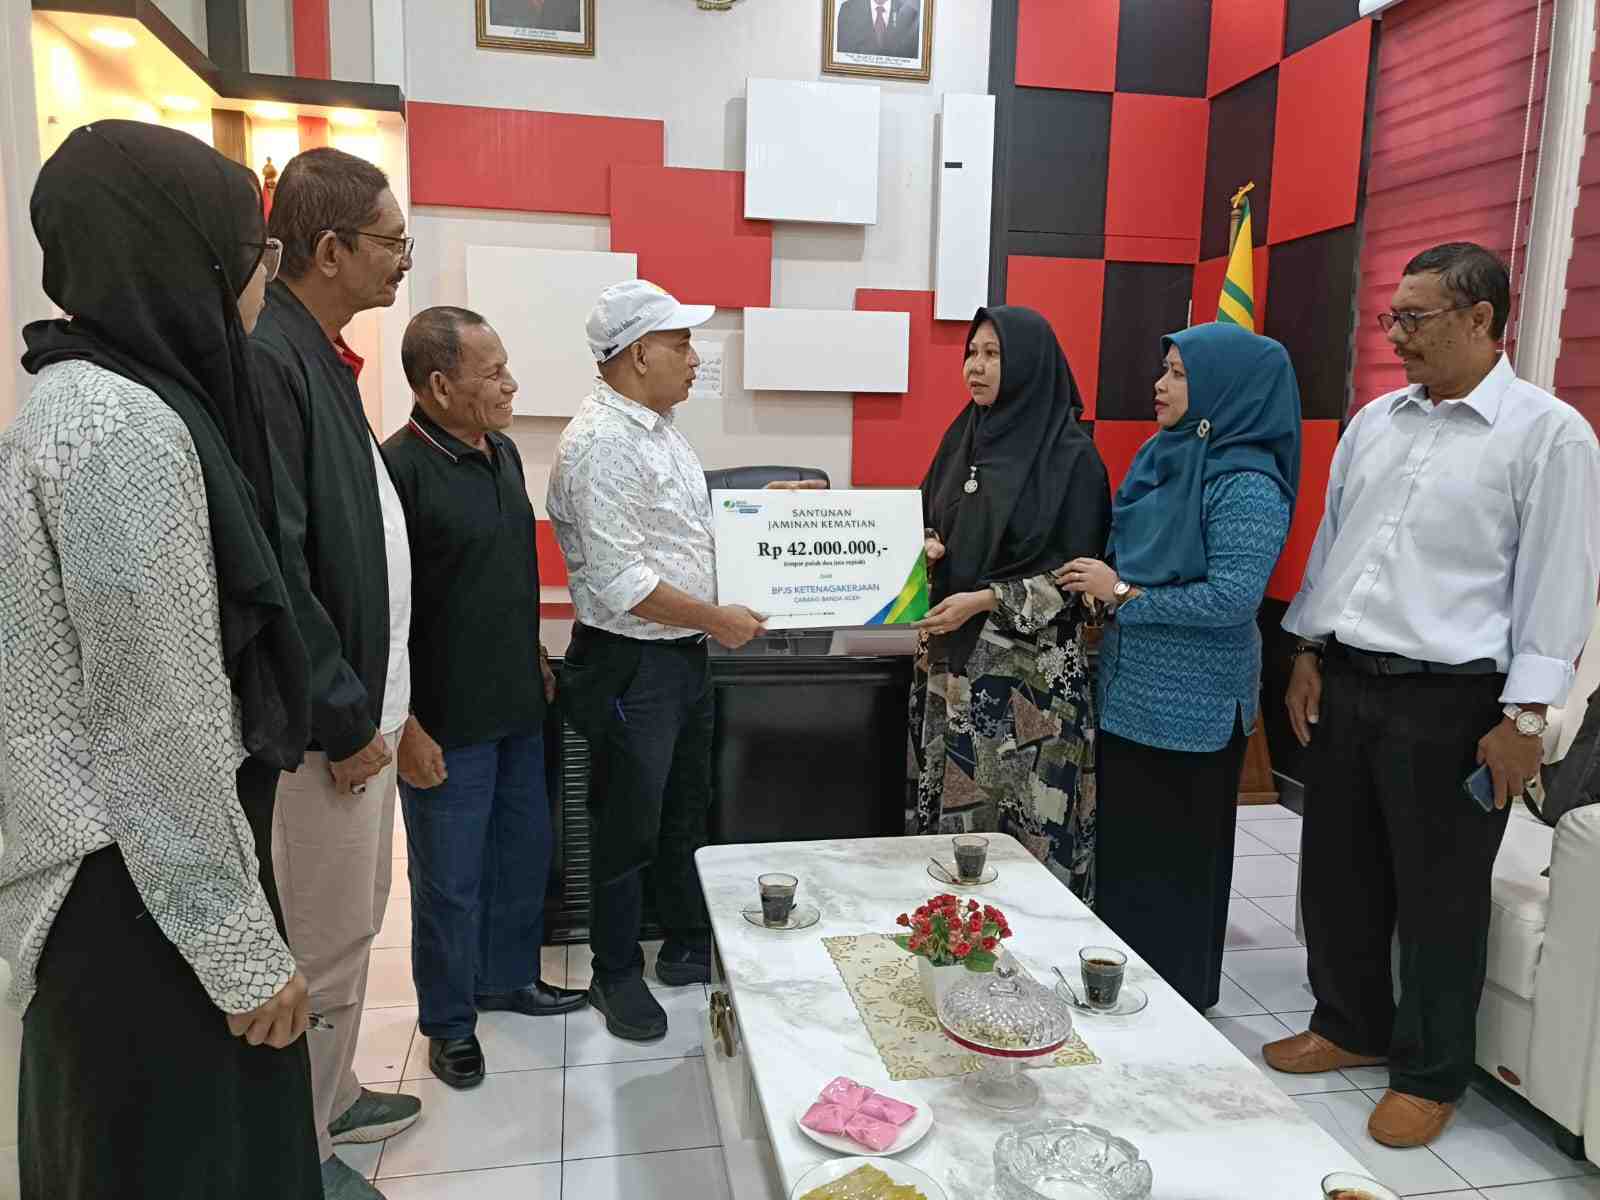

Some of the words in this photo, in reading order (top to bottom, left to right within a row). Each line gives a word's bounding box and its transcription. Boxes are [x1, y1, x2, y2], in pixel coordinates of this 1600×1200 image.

[792, 508, 852, 518] SANTUNAN
[768, 519, 818, 530] JAMINAN
[821, 519, 876, 529] KEMATIAN
[757, 541, 783, 560] Rp
[787, 540, 888, 557] 42.000.000,-
[771, 585, 793, 595] BPJS
[794, 583, 880, 594] KETENAGAKERJAAN
